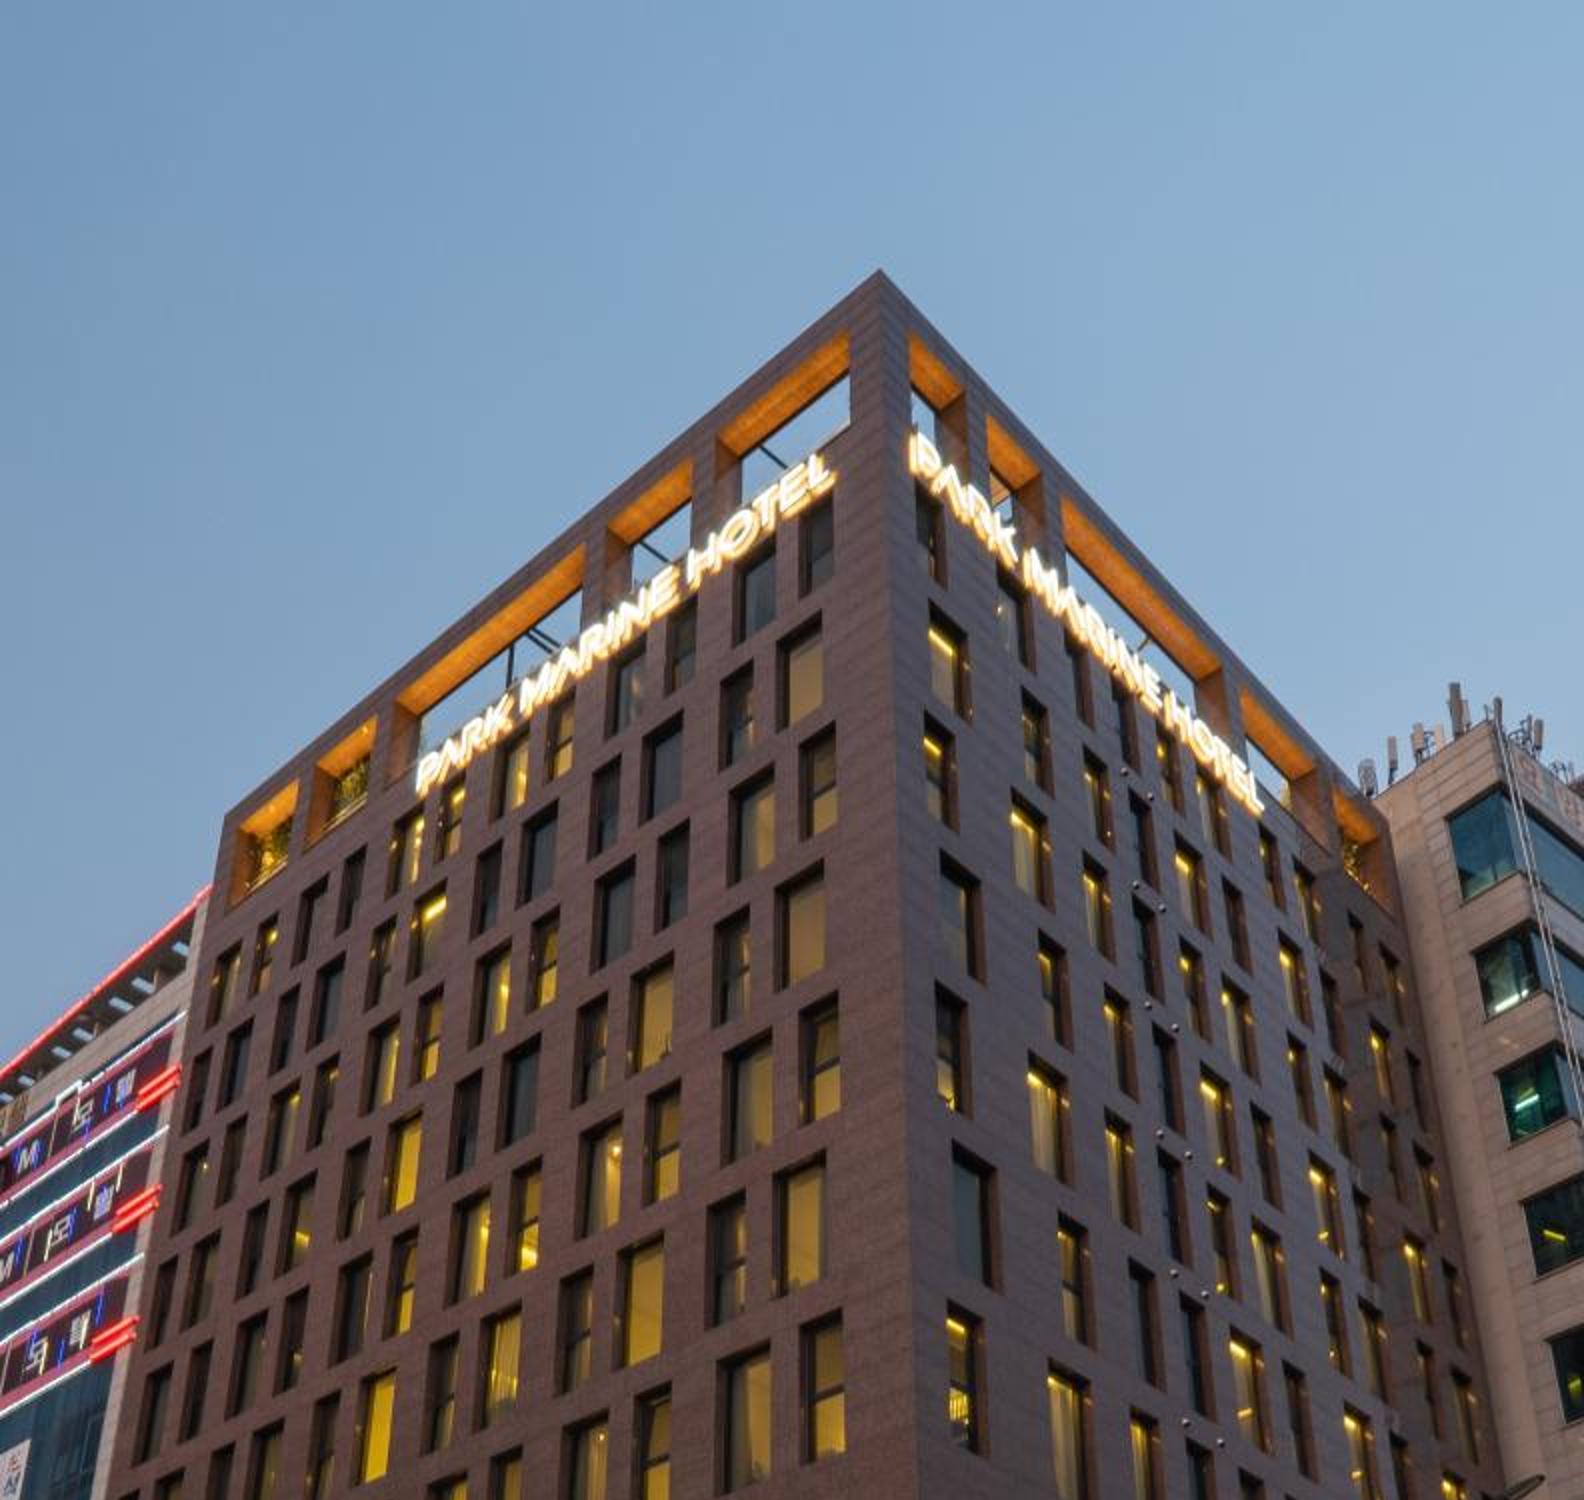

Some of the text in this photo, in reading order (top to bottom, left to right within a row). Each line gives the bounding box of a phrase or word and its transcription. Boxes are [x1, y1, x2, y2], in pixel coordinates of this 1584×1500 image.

[415, 451, 838, 797] PARK MARINE HOTEL
[907, 431, 1265, 817] PARK MARINE HOTEL
